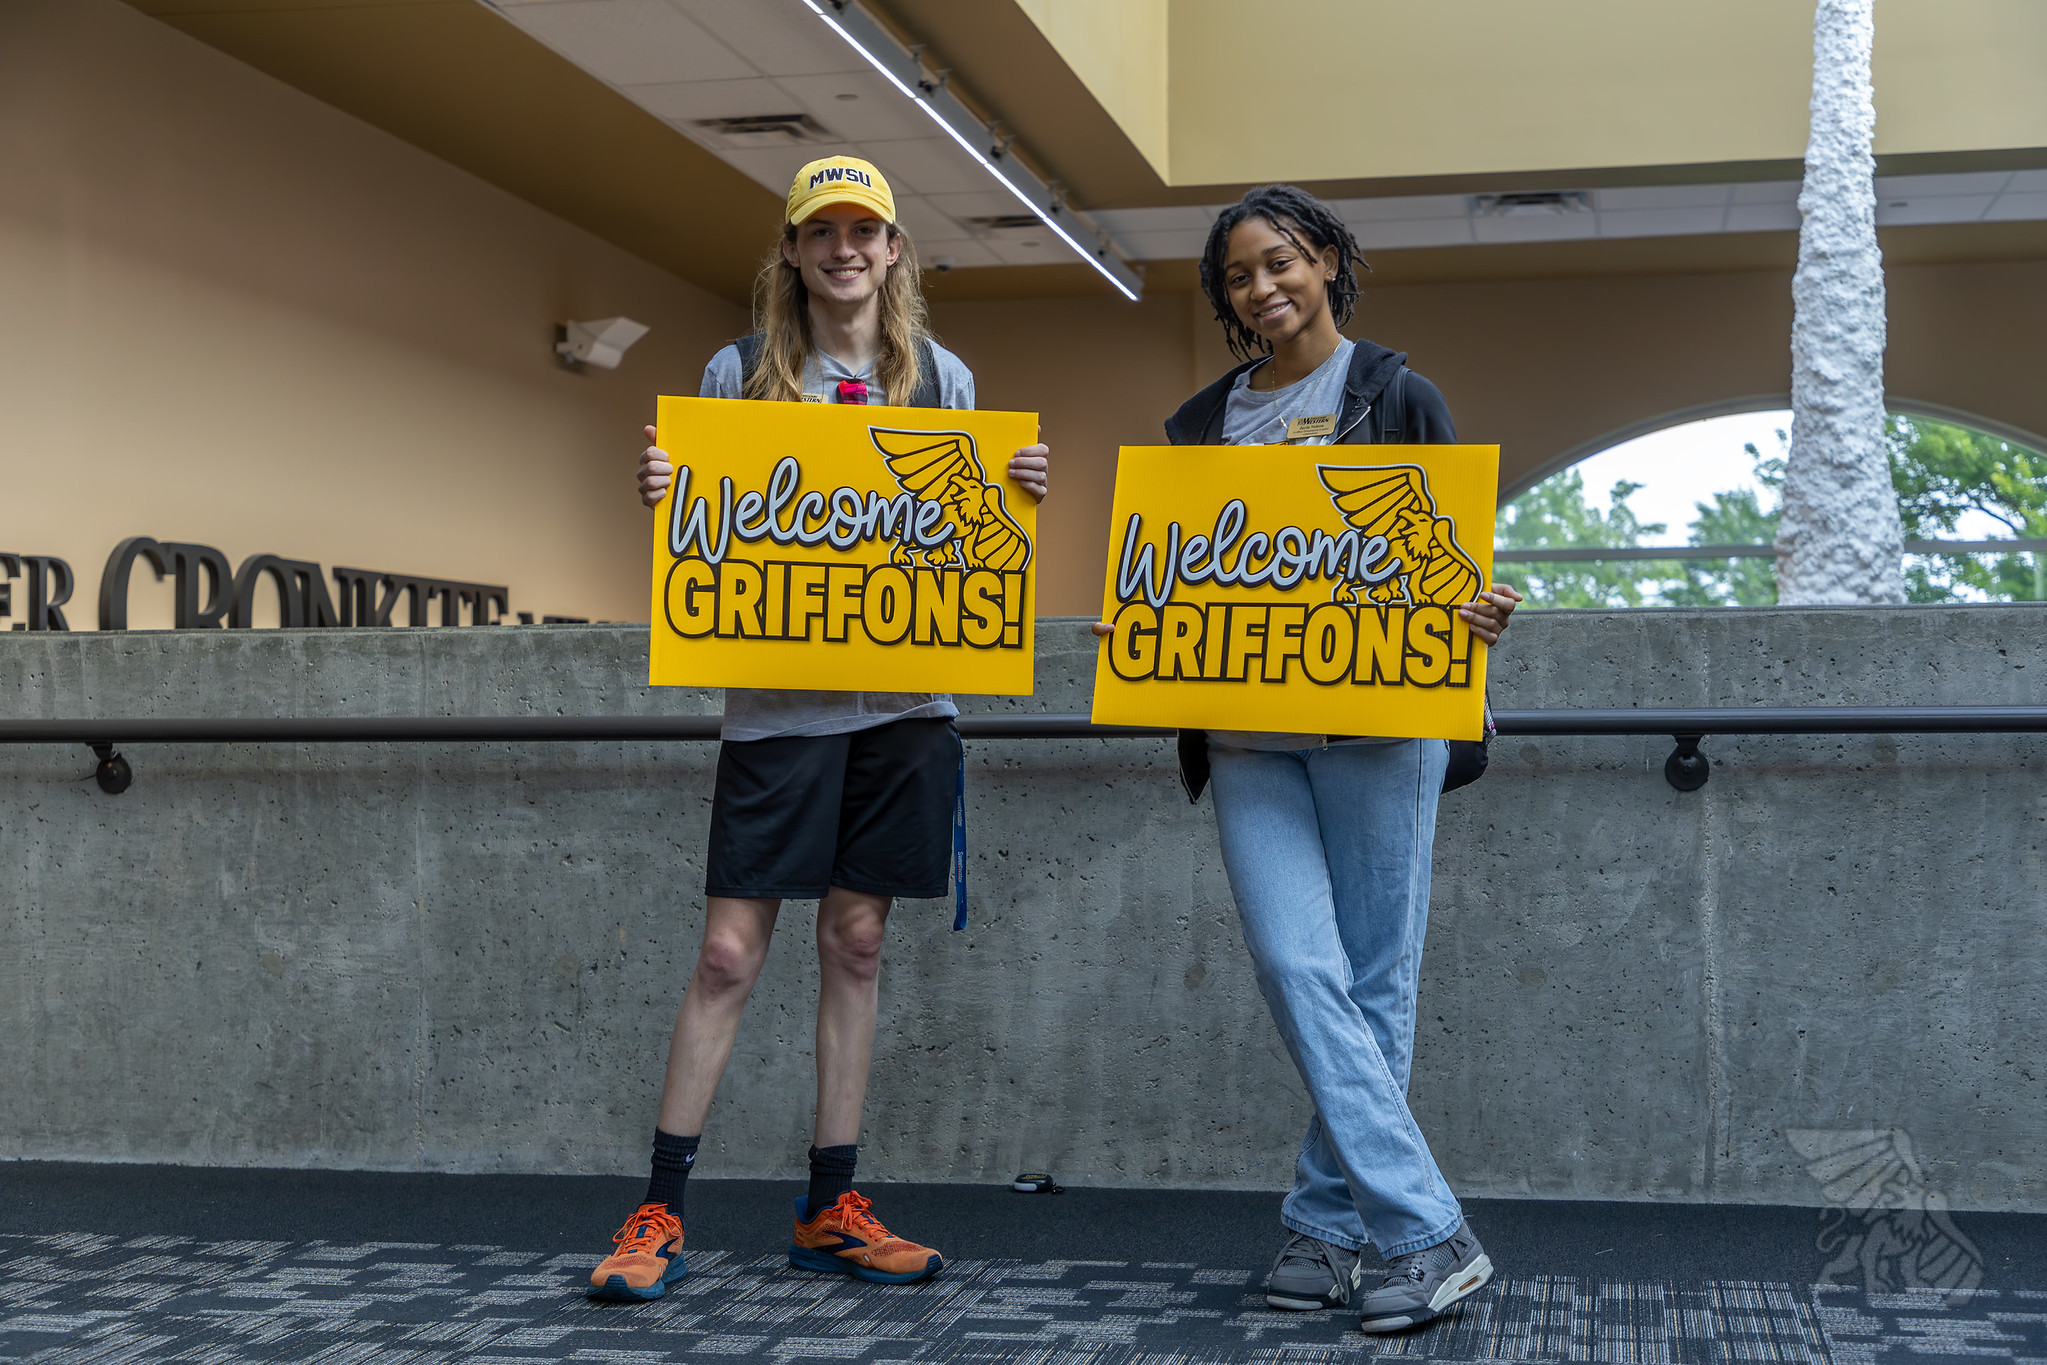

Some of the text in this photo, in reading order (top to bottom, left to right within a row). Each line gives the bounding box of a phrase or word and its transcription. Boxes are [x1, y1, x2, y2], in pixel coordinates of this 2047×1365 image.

[809, 167, 872, 190] MWSU
[668, 456, 956, 565] Welcome
[1117, 499, 1402, 607] Welcome
[664, 556, 1026, 649] GRIFFONS!
[1108, 601, 1473, 688] GRIFFONS!
